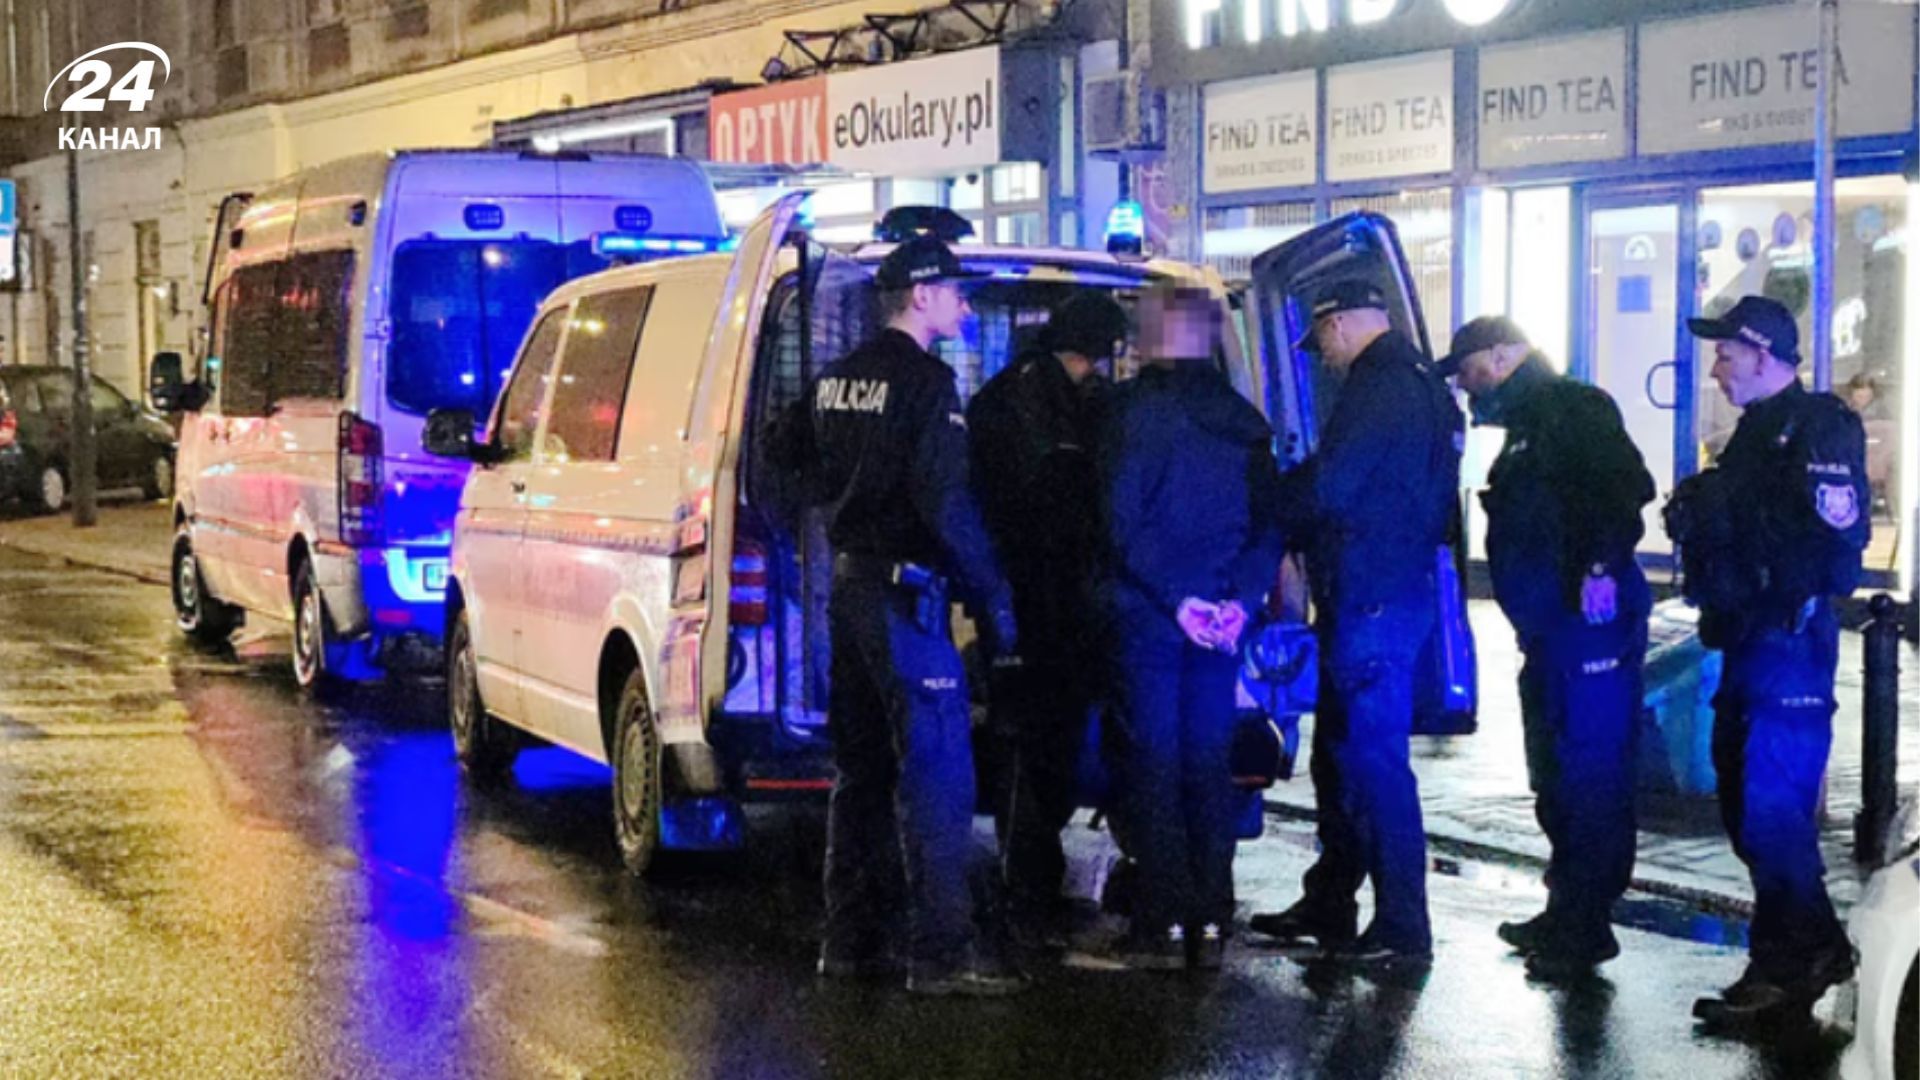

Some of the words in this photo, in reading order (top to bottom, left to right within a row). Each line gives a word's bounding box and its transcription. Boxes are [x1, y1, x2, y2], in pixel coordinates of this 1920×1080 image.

[1482, 85, 1548, 124] FIND
[1557, 75, 1616, 113] TEA
[1690, 57, 1767, 101] FIND
[715, 96, 822, 163] OPTYK
[834, 78, 993, 149] eOkulary.pl
[1208, 118, 1258, 152] FIND
[1266, 112, 1312, 147] TEA
[1330, 101, 1388, 140] FIND
[1395, 95, 1446, 132] TEA
[815, 376, 890, 415] POLICJA
